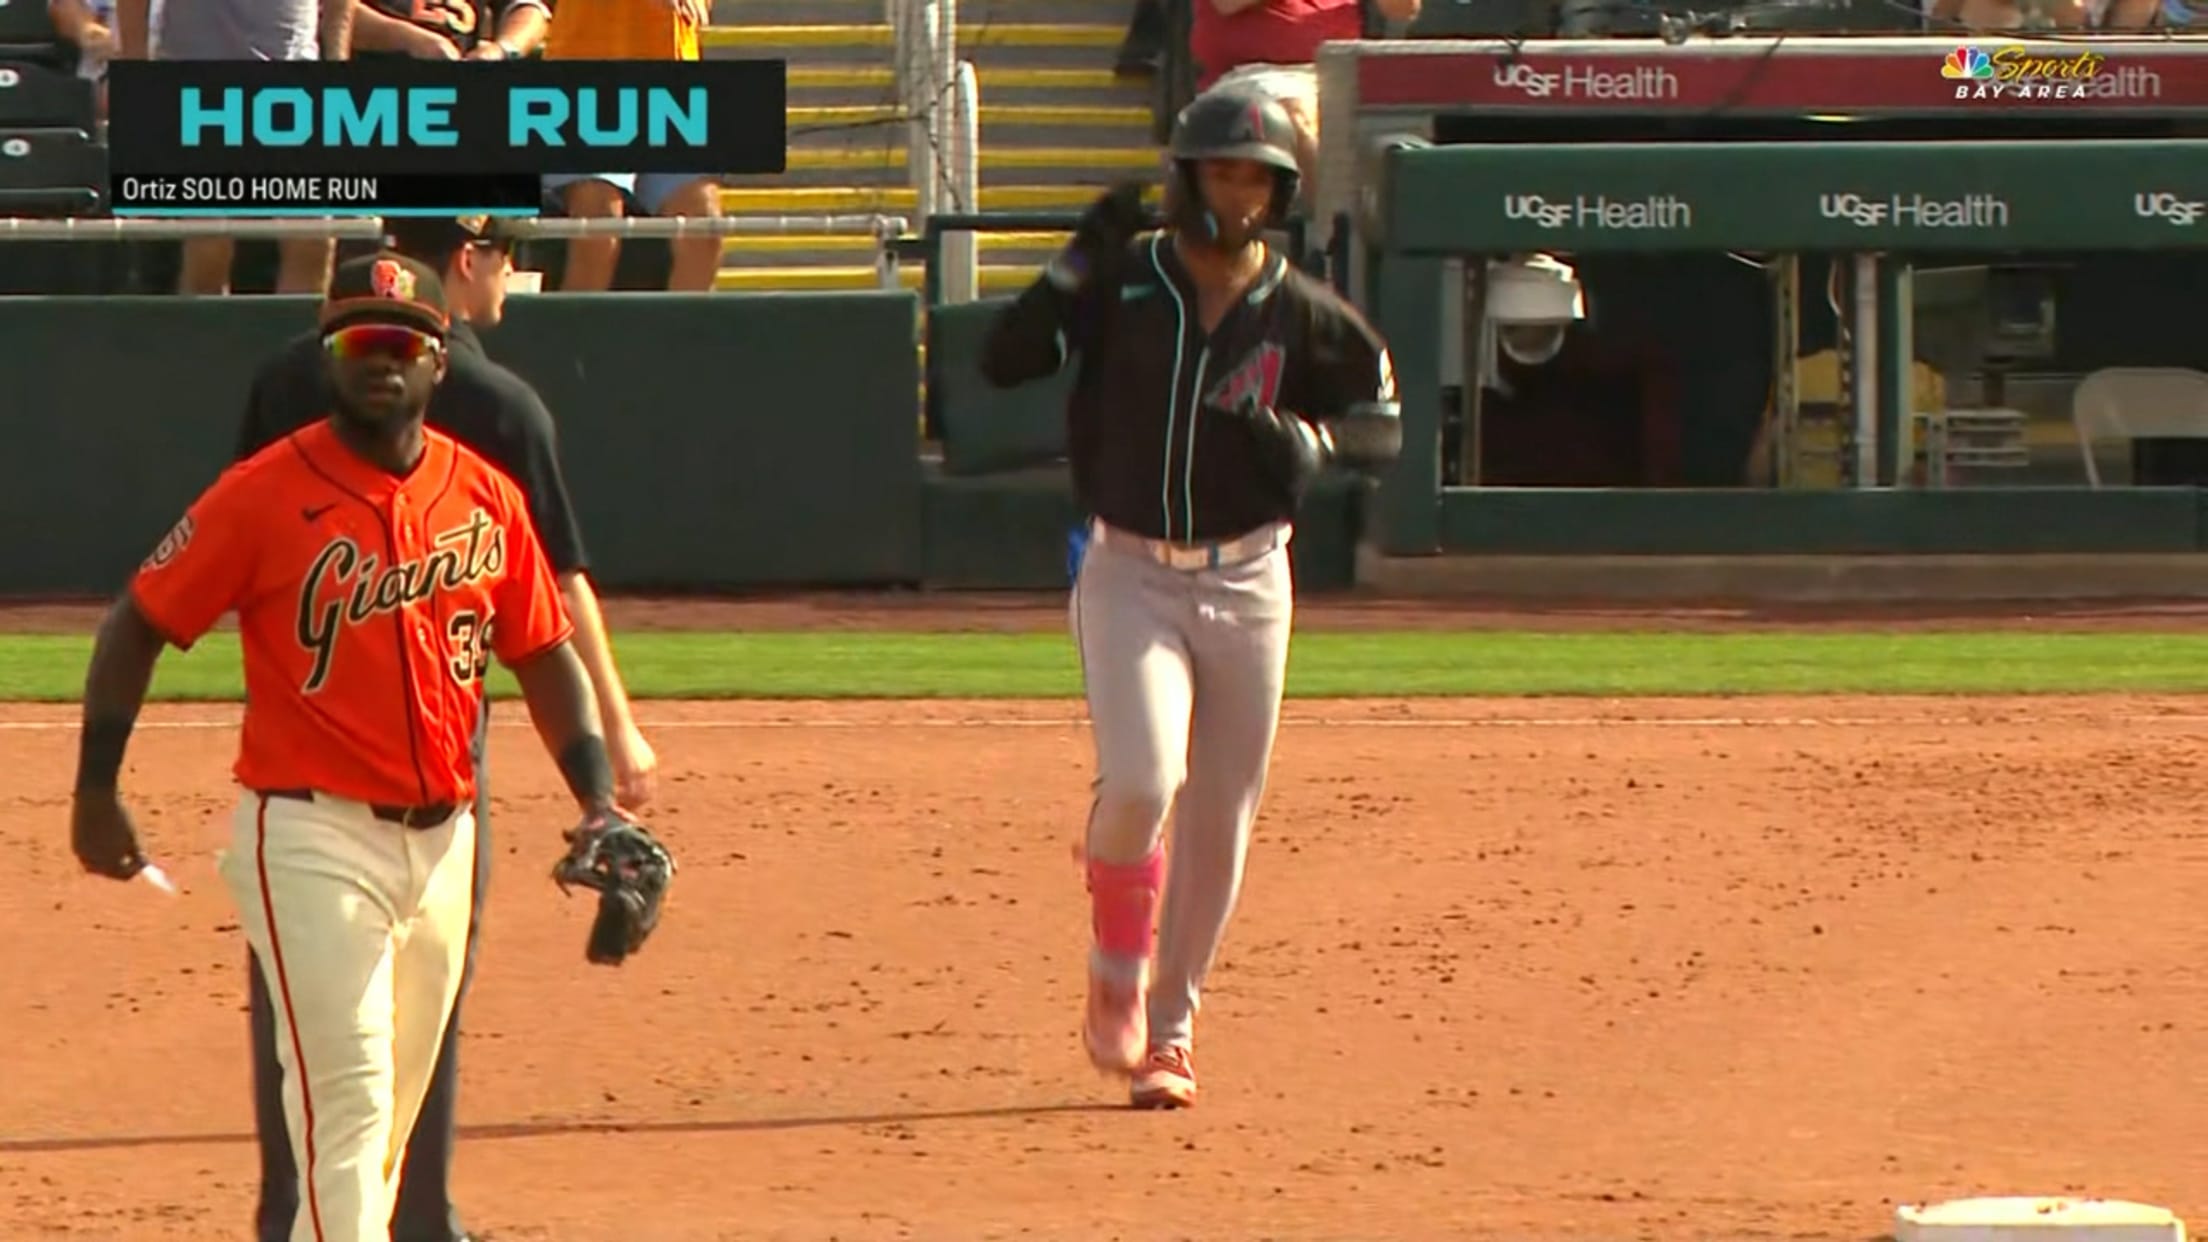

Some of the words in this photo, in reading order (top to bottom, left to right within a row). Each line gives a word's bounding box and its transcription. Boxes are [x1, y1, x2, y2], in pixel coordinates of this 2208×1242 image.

[1493, 64, 1560, 96] UCSF
[1564, 65, 1679, 98] Health
[1504, 195, 1573, 228] UCSF
[1576, 195, 1692, 229] Health
[1819, 193, 1889, 227] UCSF
[1892, 194, 2008, 227] Health
[2134, 193, 2204, 225] UCSF
[296, 507, 505, 694] Giants
